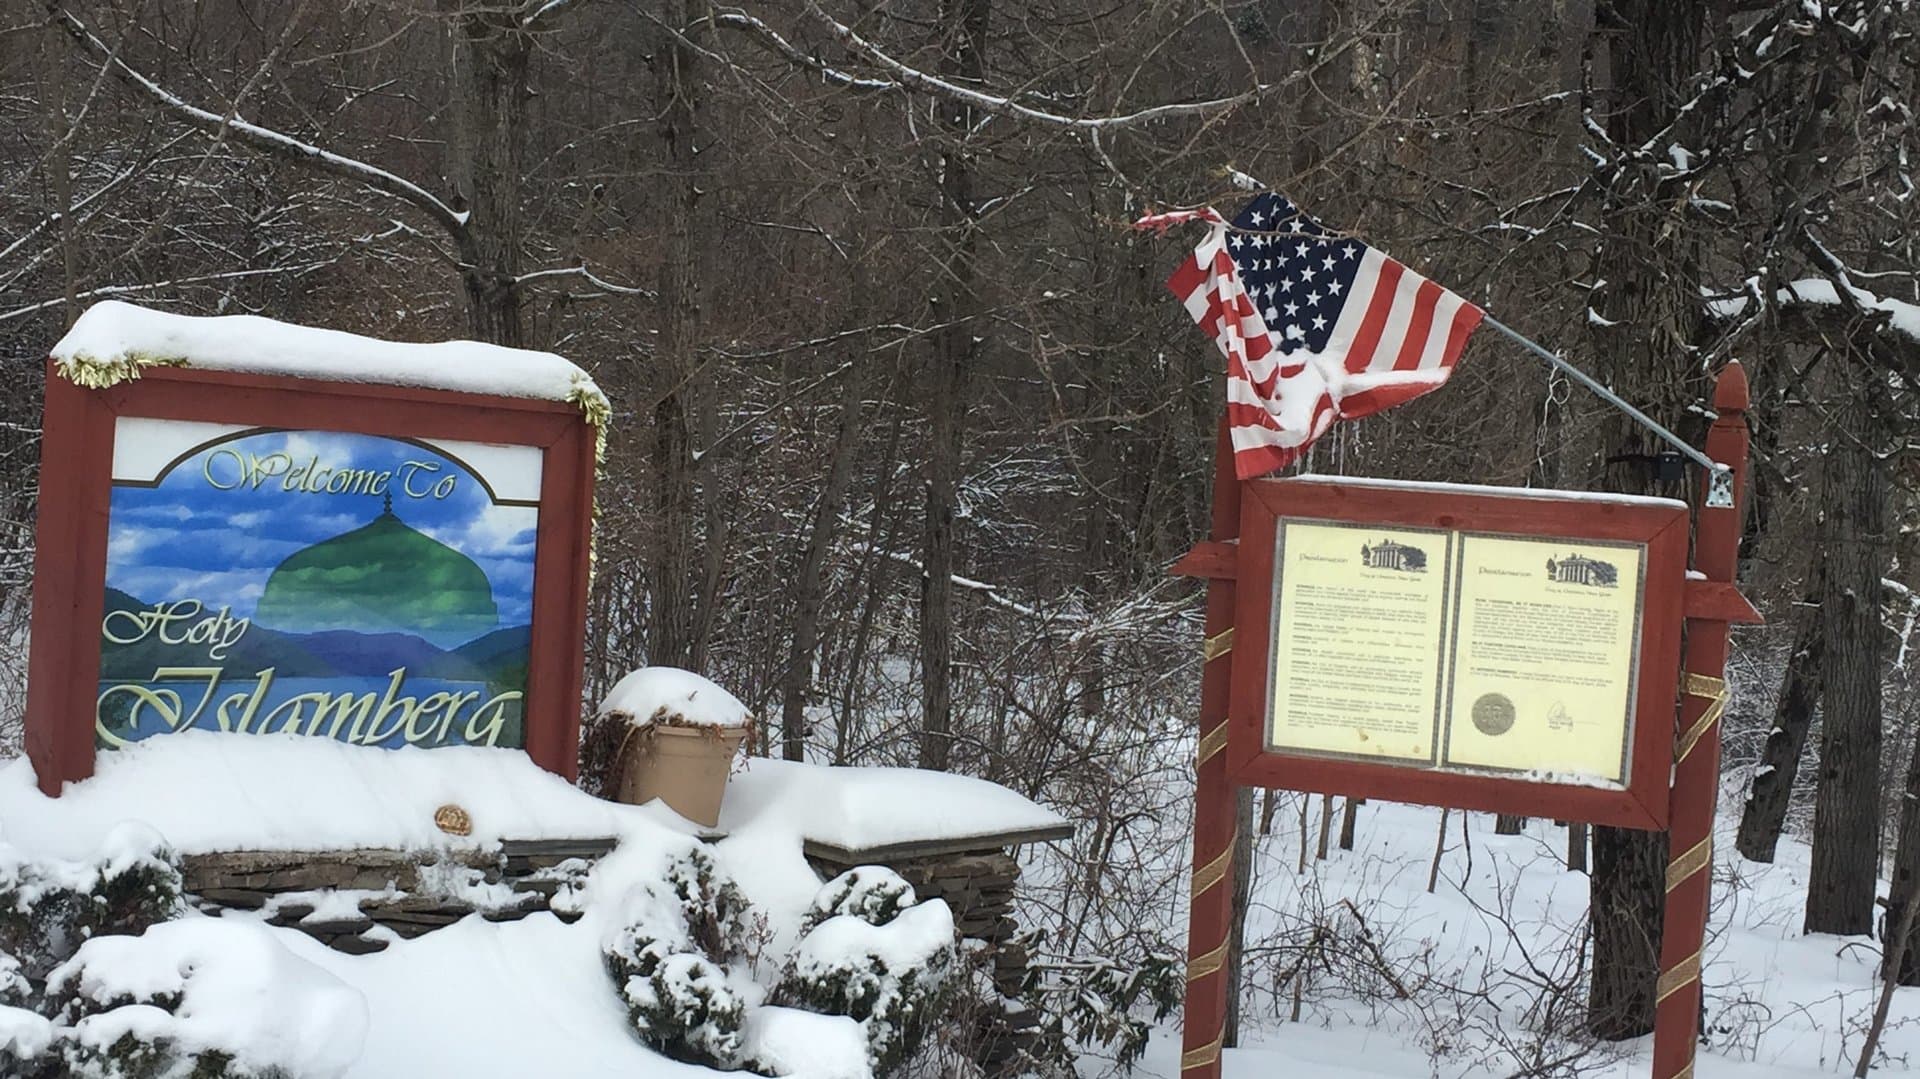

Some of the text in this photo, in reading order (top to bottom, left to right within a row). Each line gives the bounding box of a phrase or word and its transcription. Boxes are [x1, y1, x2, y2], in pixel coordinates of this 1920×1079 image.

[203, 448, 456, 500] Welcome To
[102, 598, 253, 660] Holy
